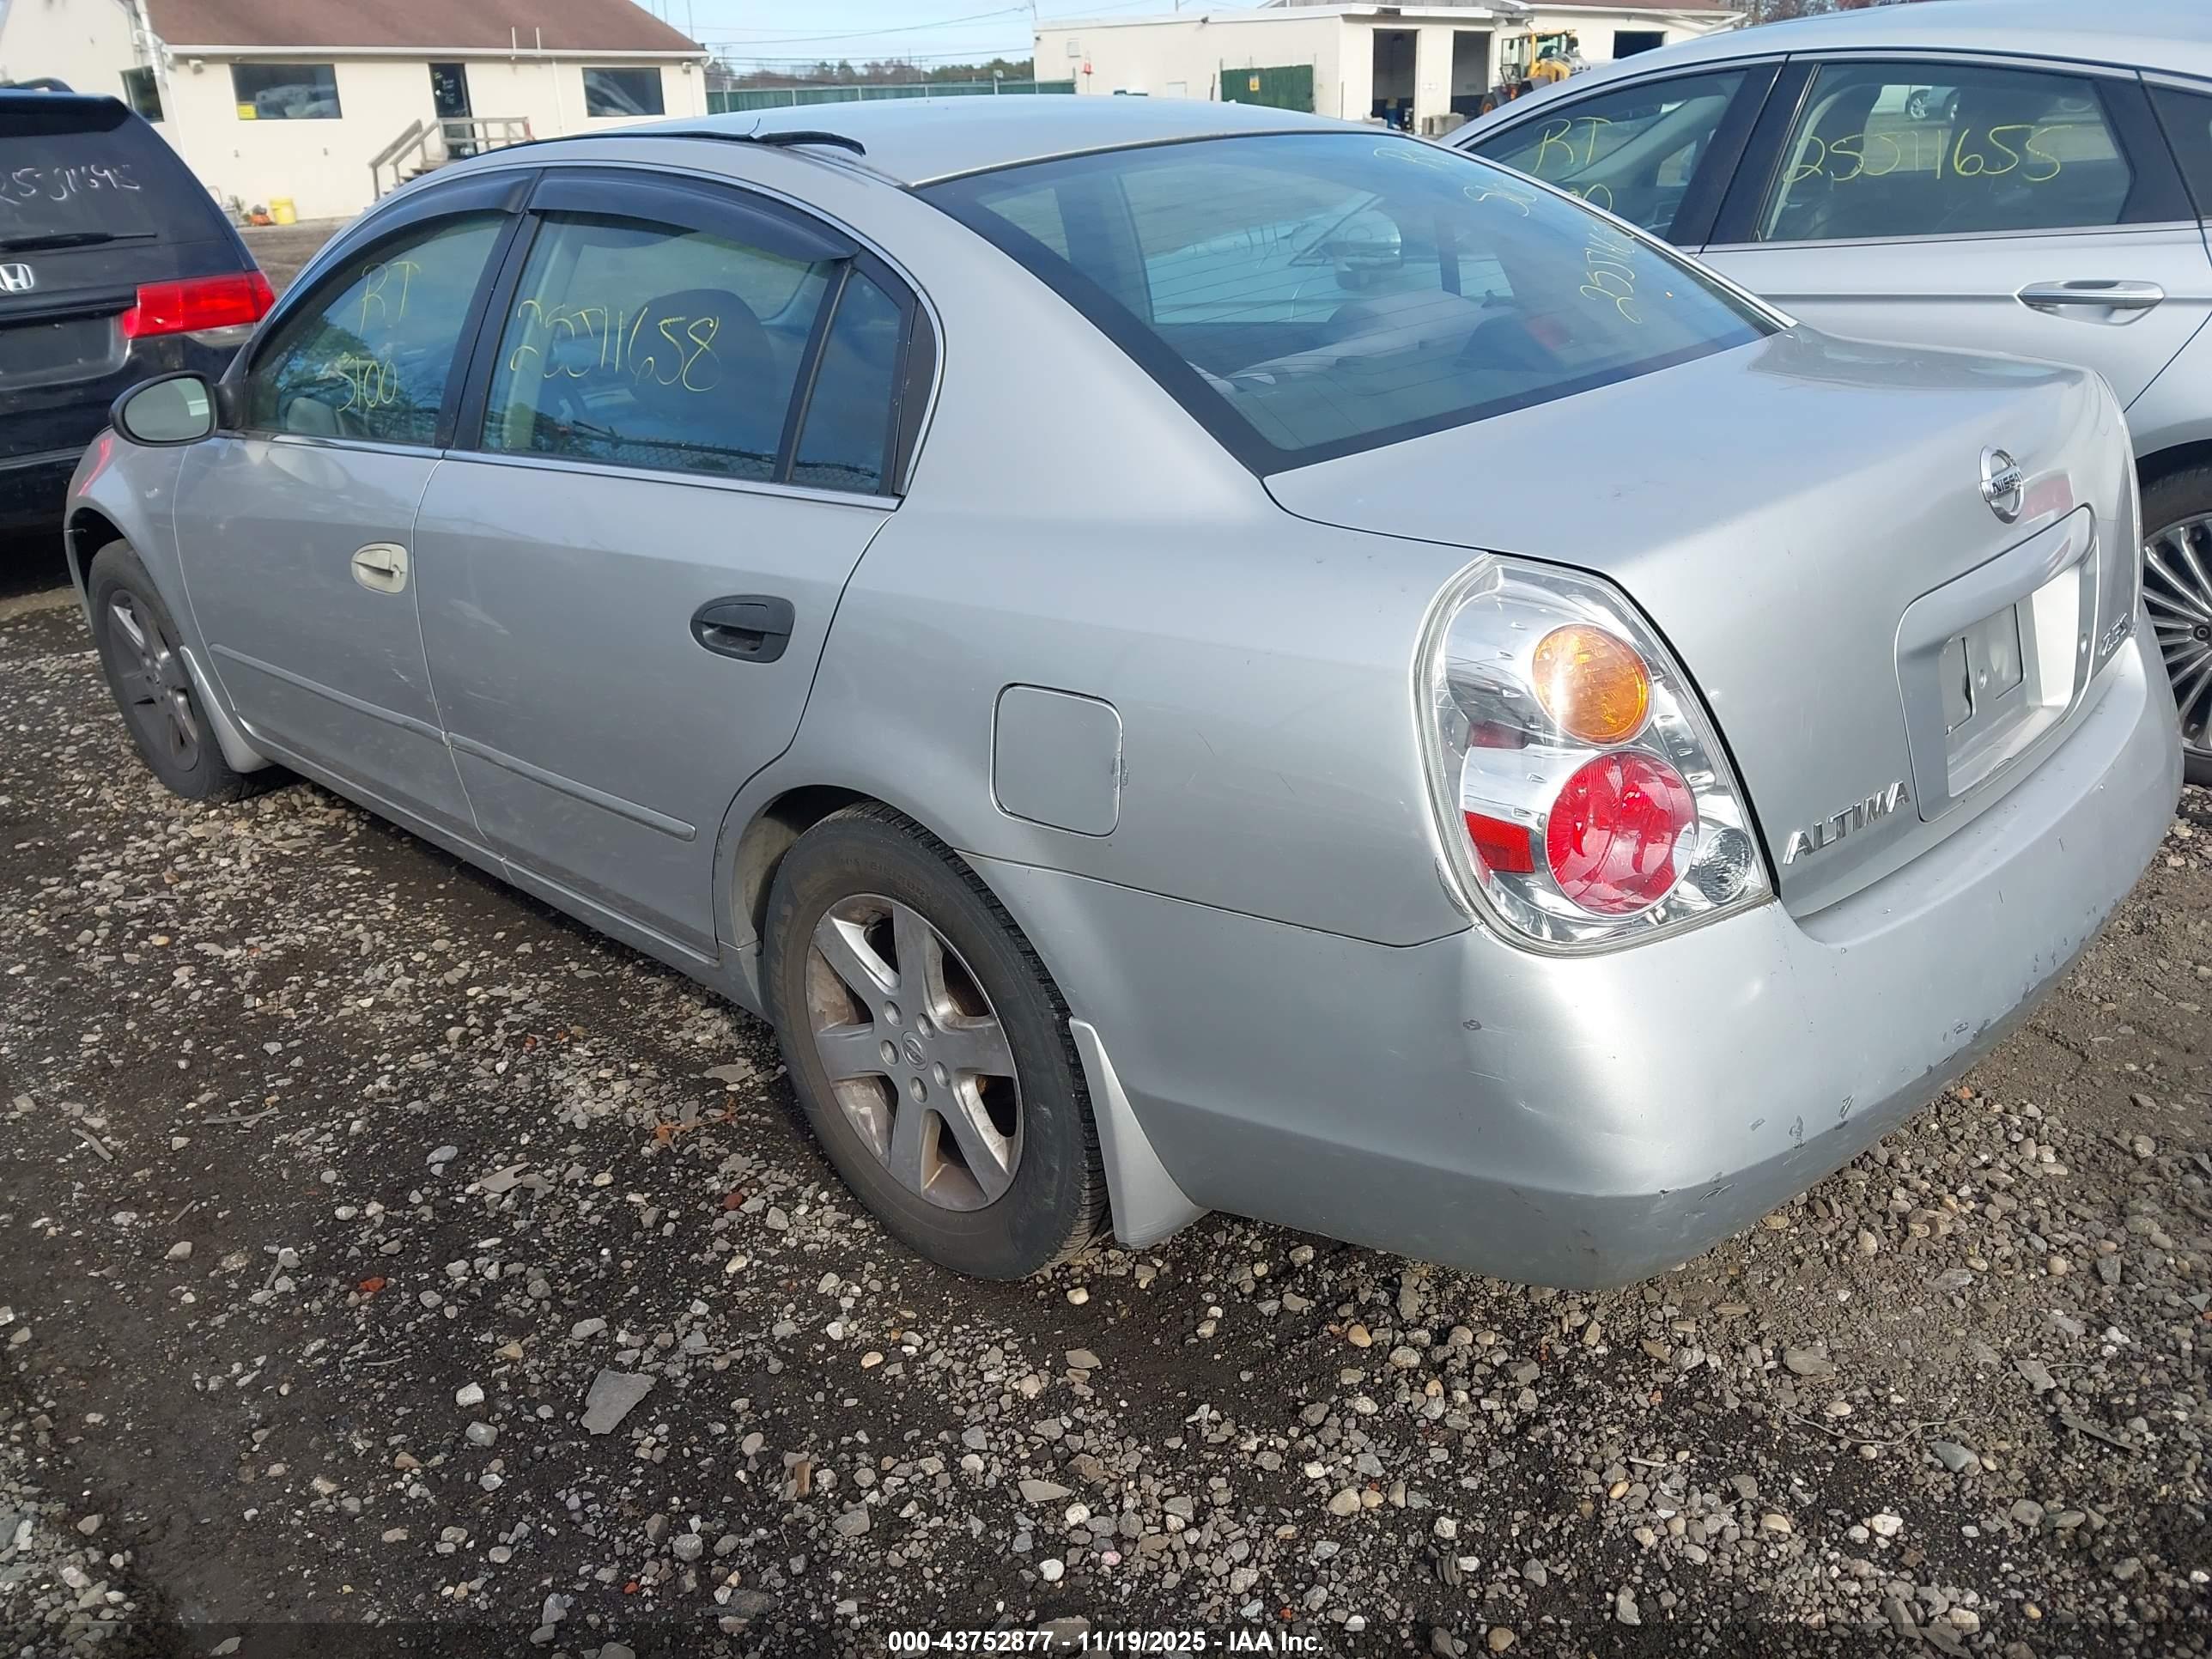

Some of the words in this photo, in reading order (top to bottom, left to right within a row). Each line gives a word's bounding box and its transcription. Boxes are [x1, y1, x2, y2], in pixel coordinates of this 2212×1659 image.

[1534, 116, 1614, 175] RT
[357, 260, 421, 337] RT
[1991, 469, 2024, 495] NISSA
[1783, 779, 1911, 866] ALTIMA
